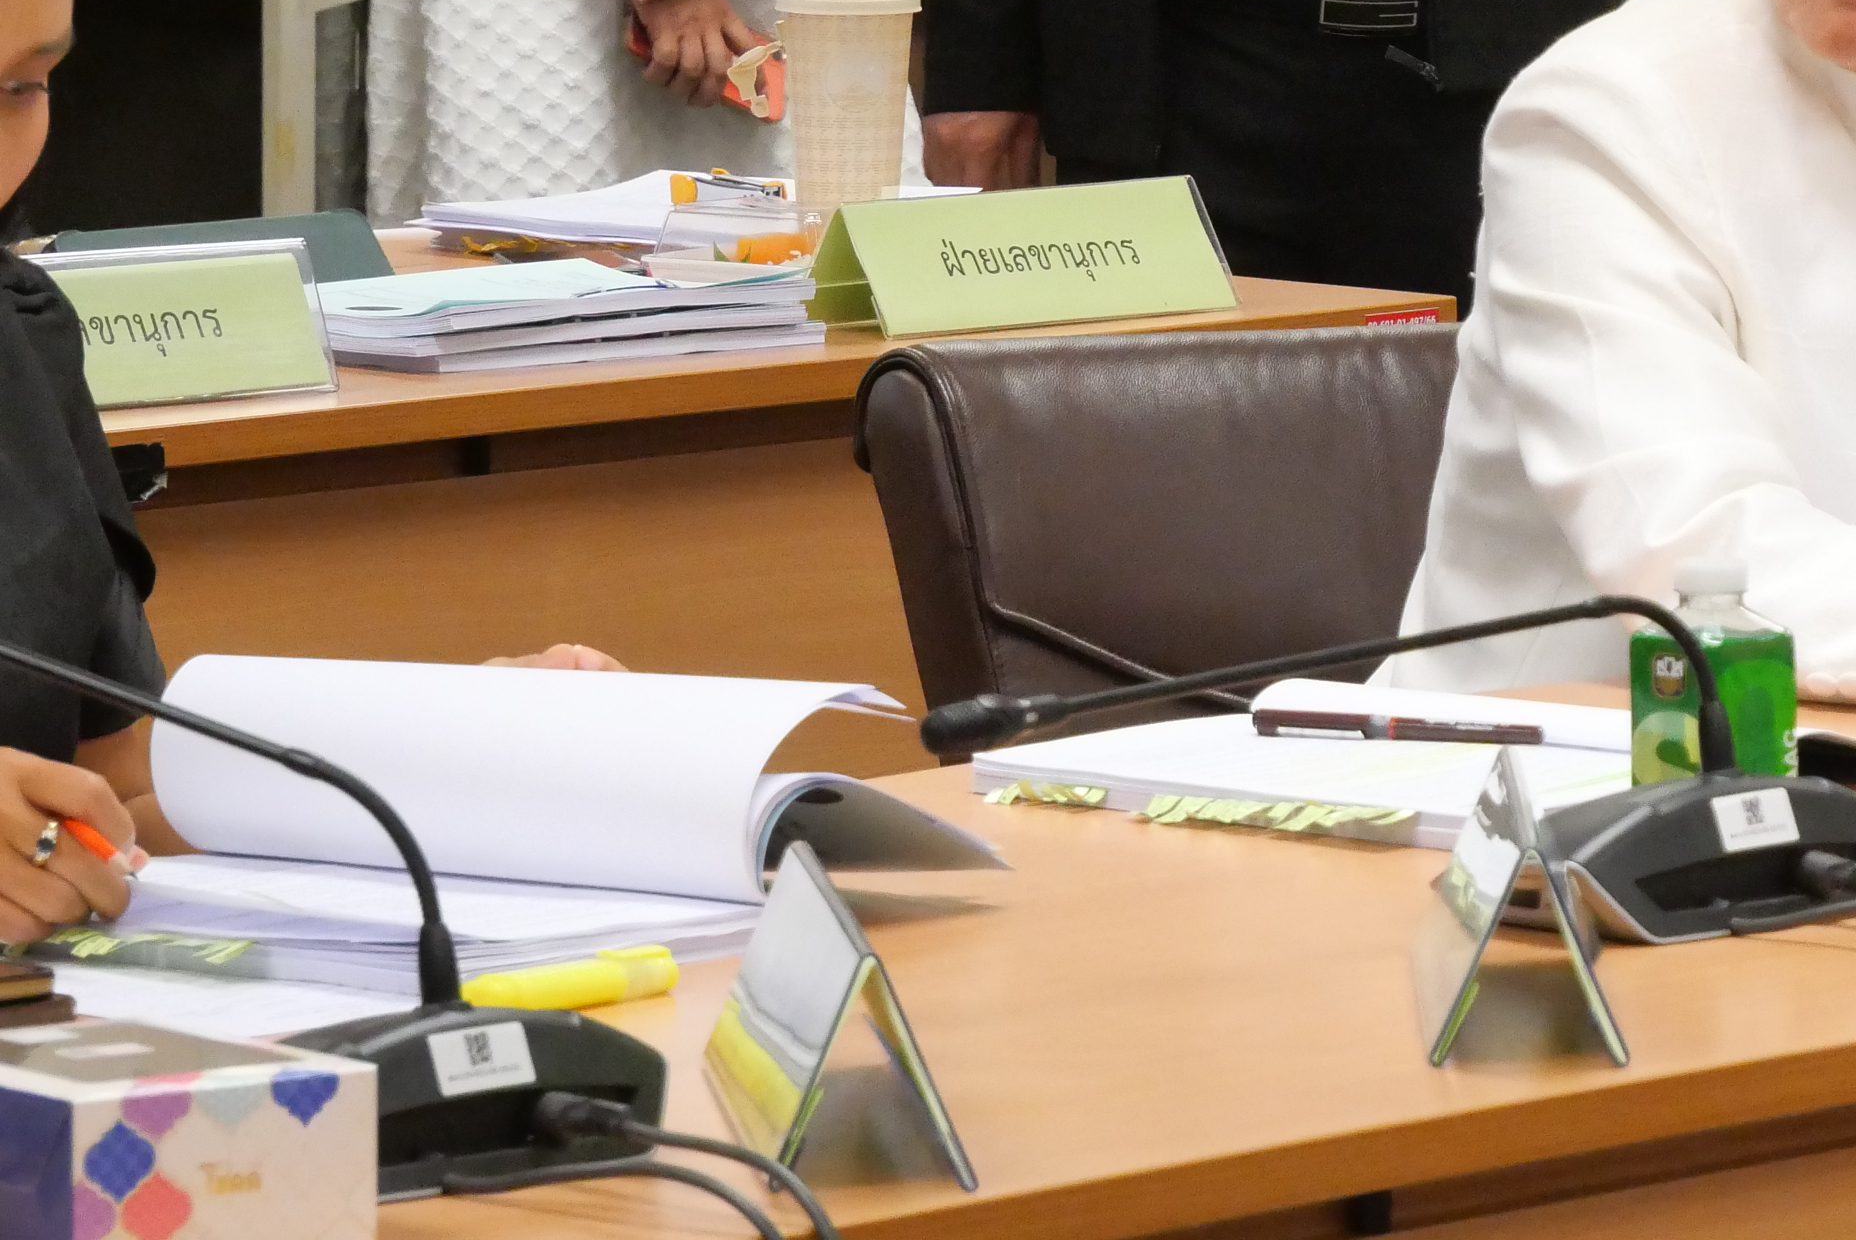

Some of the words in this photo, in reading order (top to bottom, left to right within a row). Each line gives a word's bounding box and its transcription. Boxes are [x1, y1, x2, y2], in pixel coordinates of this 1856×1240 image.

[940, 238, 1141, 282] ฝ่ายเลขานุการ
